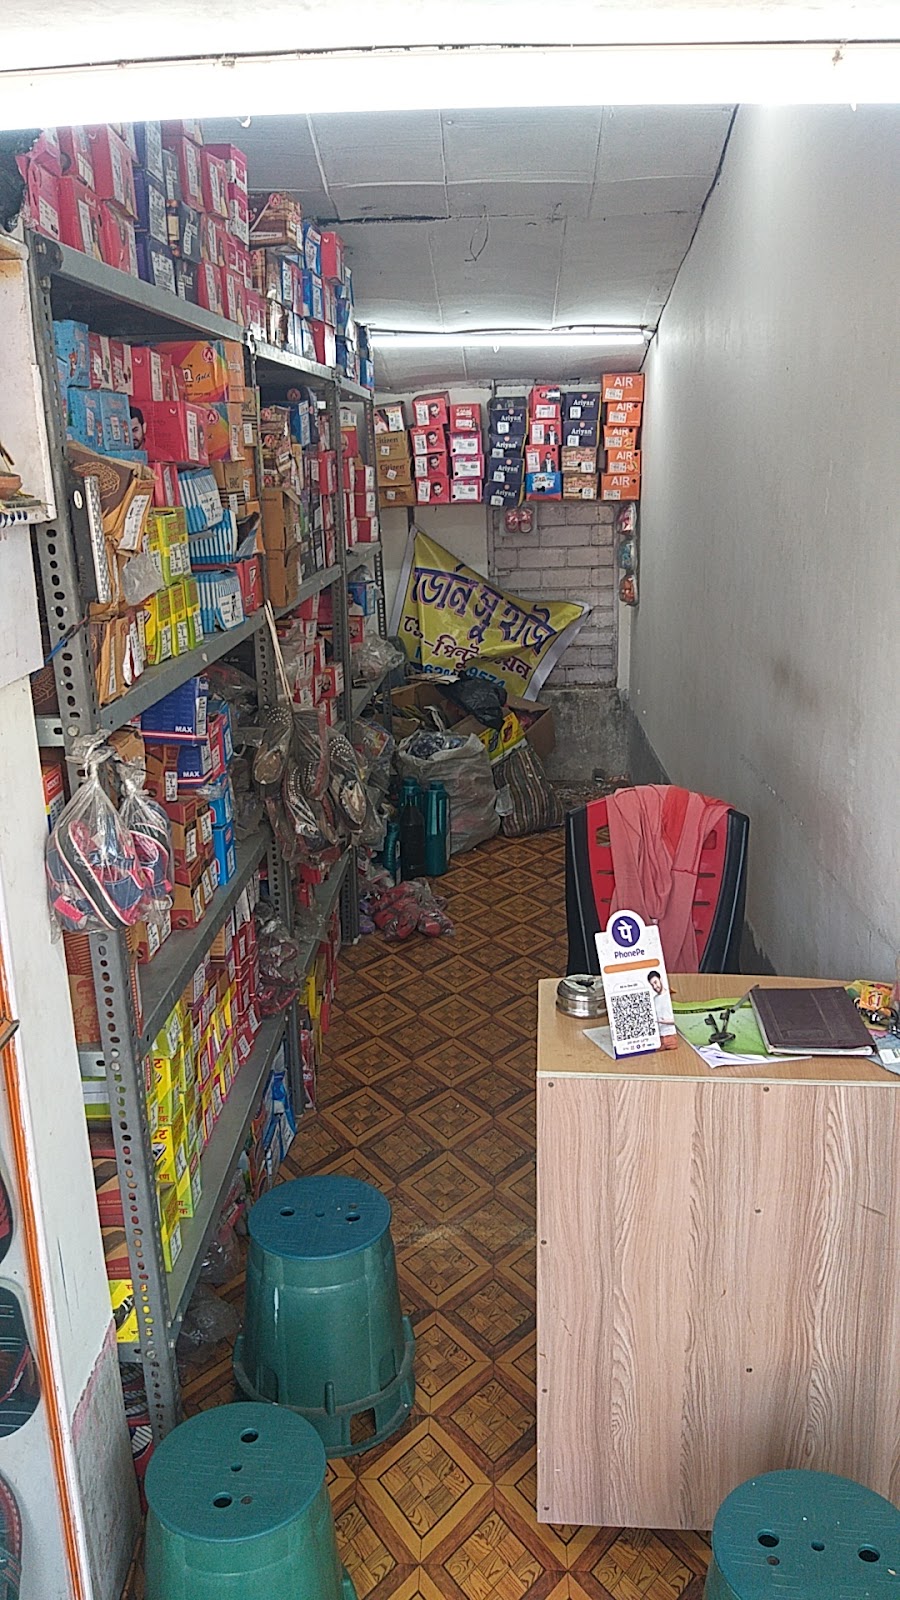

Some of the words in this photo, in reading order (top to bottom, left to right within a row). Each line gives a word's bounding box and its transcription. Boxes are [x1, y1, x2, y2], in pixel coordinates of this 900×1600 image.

[614, 377, 633, 387] AIR
[573, 399, 596, 407] Ariyan
[617, 402, 633, 411] AIR
[501, 414, 522, 422] Ariyan
[571, 427, 593, 435] Ariyan
[612, 427, 629, 435] AIR
[496, 441, 518, 449] Ariyan
[616, 451, 633, 460] AIR
[498, 464, 520, 472] Ariyan
[611, 476, 630, 486] AIR
[496, 489, 517, 498] Ariyan
[175, 726, 193, 734] MAX
[614, 948, 645, 959] PhonePe
